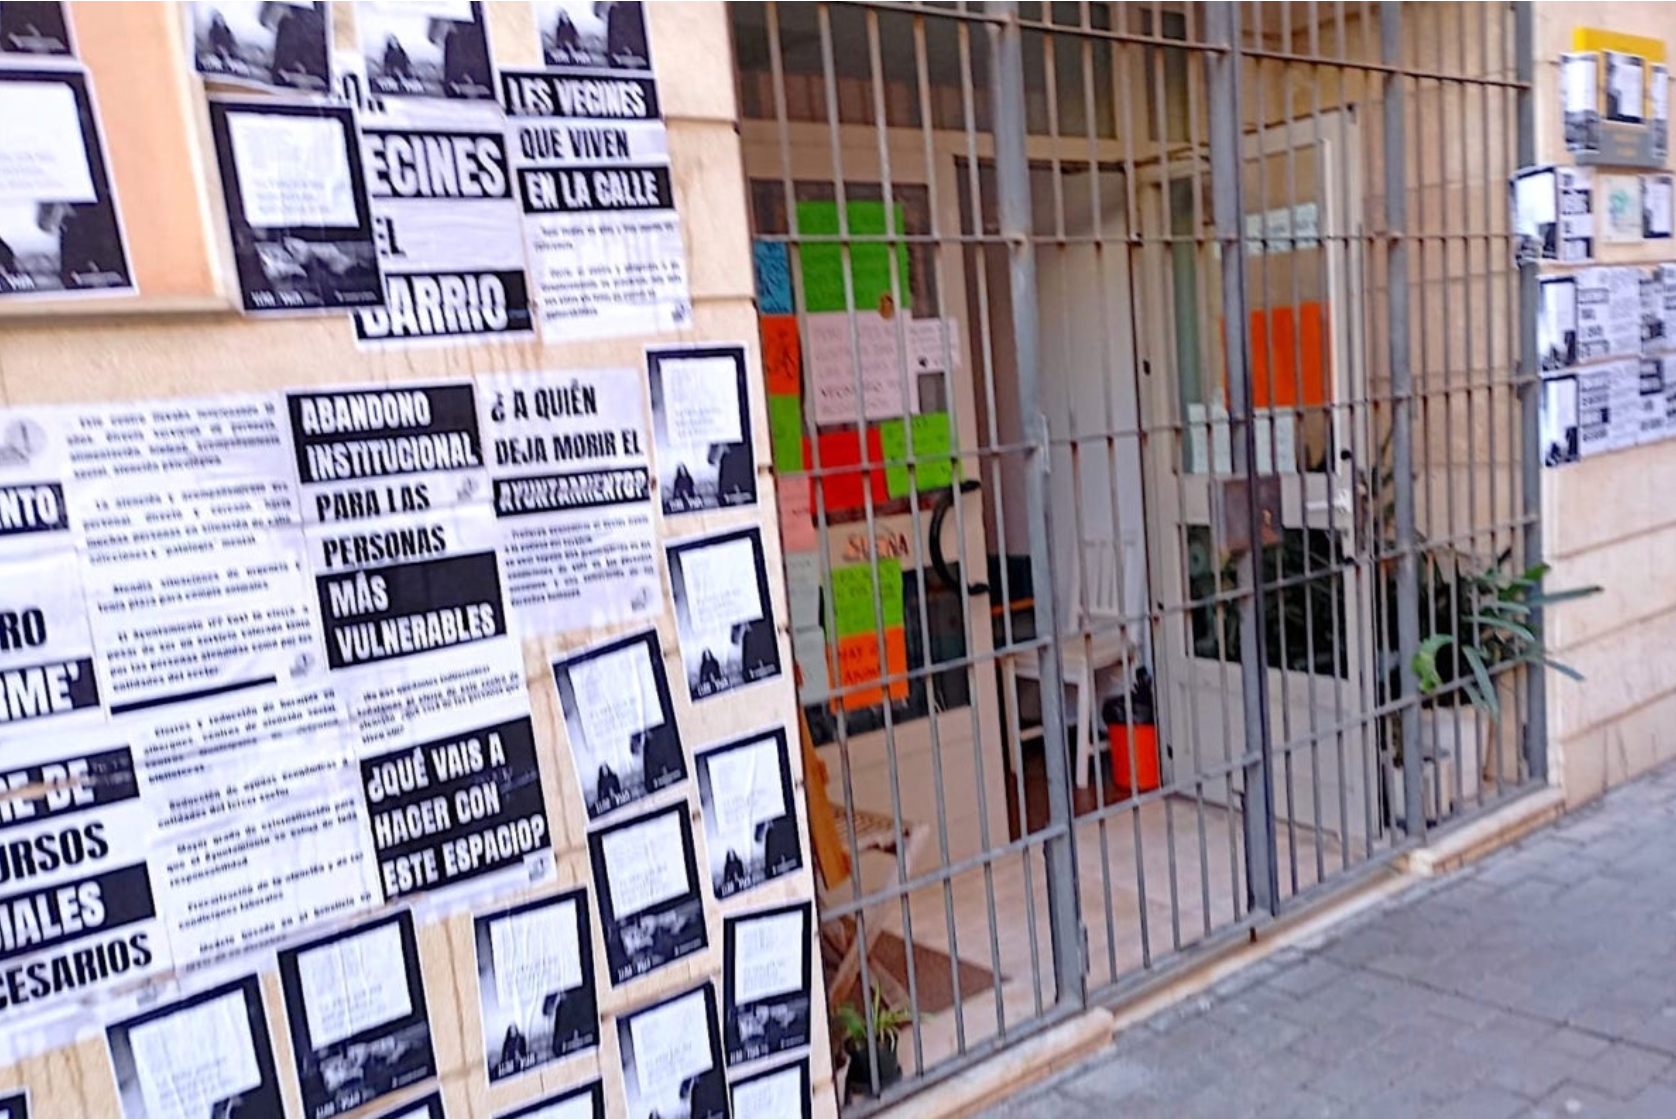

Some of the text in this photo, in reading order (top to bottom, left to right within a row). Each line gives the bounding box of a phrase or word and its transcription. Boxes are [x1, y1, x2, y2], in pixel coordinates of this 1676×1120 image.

[364, 134, 506, 197] ECINES
[520, 128, 631, 160] QUE VIVEN
[524, 171, 660, 209] EN LA CALLE
[302, 392, 431, 435] ABANDONO
[514, 389, 530, 420] A
[535, 380, 598, 422] QUIÉN
[306, 433, 479, 481] INSTITUCIONAL
[494, 429, 644, 465] DEJA MORIR EL
[317, 485, 430, 522] PARA LAS
[323, 526, 446, 567] PERSONAS
[328, 570, 388, 618] MÁS
[335, 603, 496, 663] VULNERABLES
[368, 733, 506, 802] ¿QUÉ VAIS A
[375, 782, 500, 850] HACER CON
[382, 814, 546, 897] ESTE ESPACIO?
[0, 933, 152, 1010] ESARIOS
